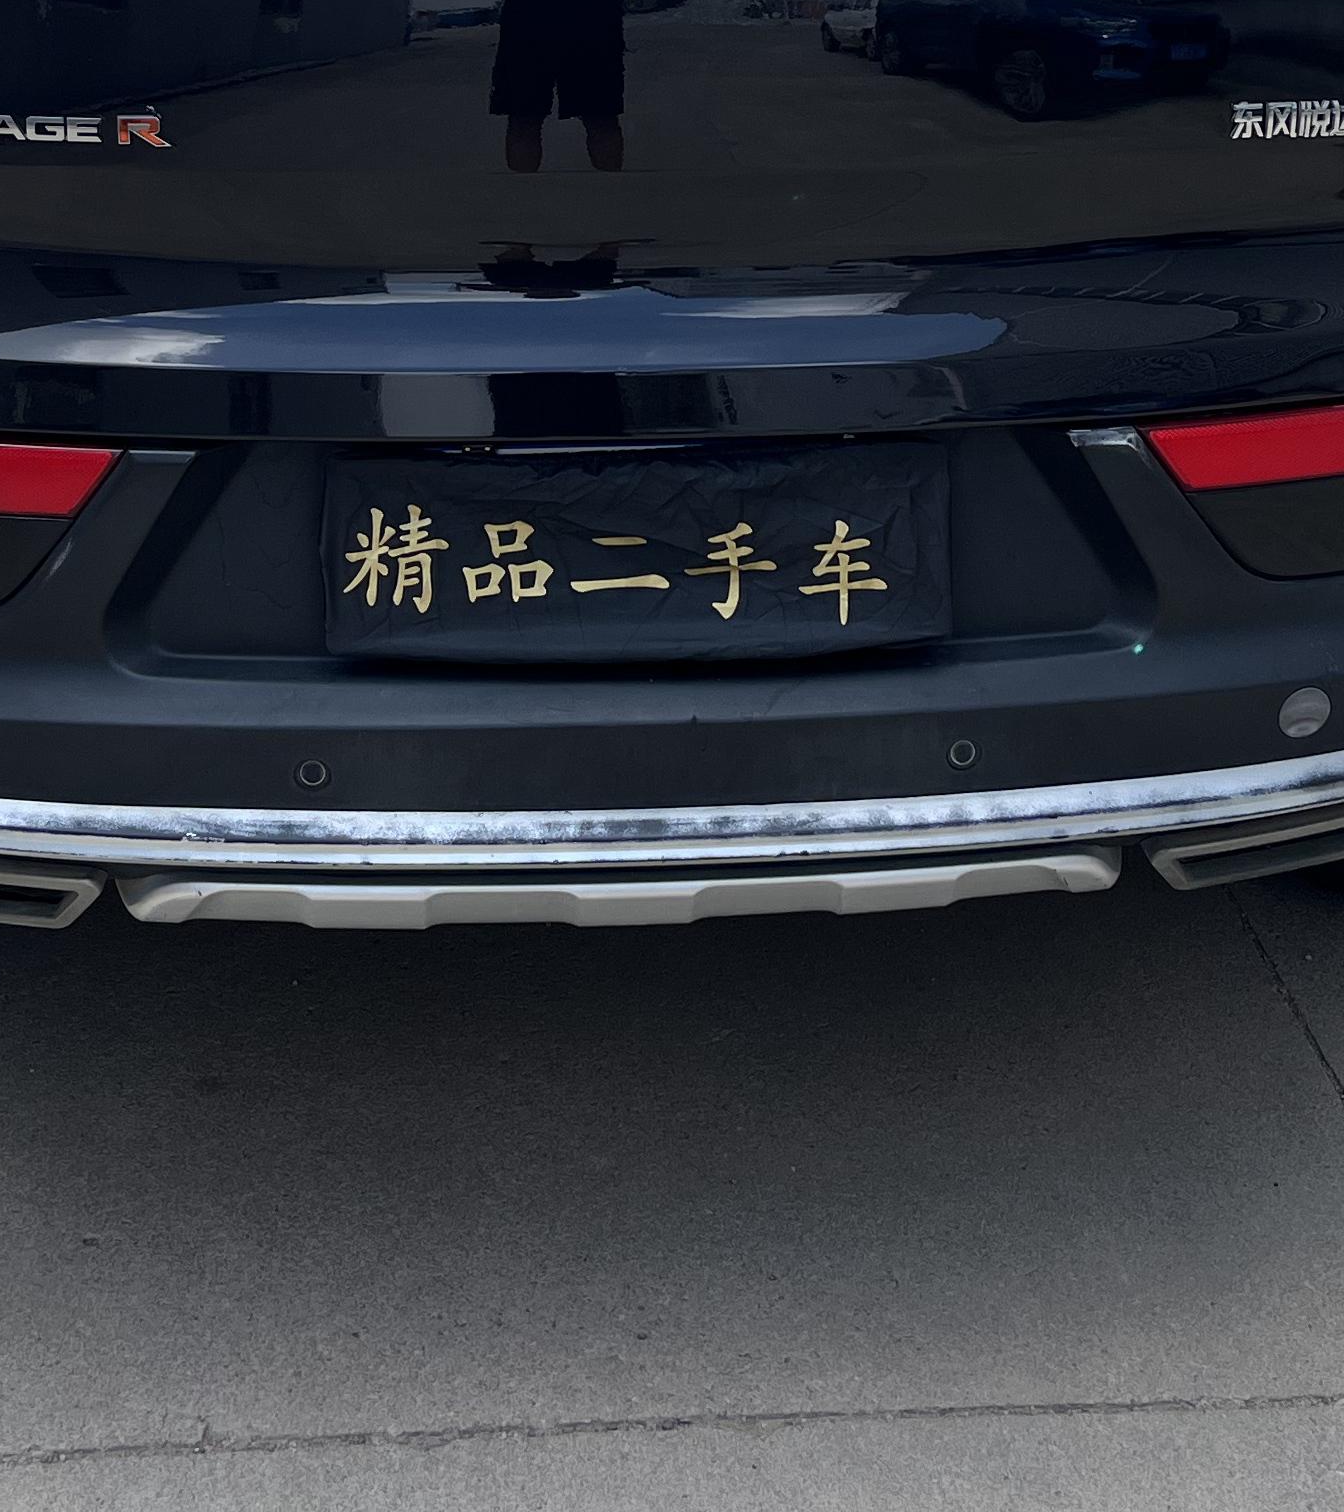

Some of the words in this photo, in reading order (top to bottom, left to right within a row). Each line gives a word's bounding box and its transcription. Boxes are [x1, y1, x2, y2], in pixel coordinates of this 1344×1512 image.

[116, 114, 172, 148] R
[343, 503, 888, 626] 精品二手车
